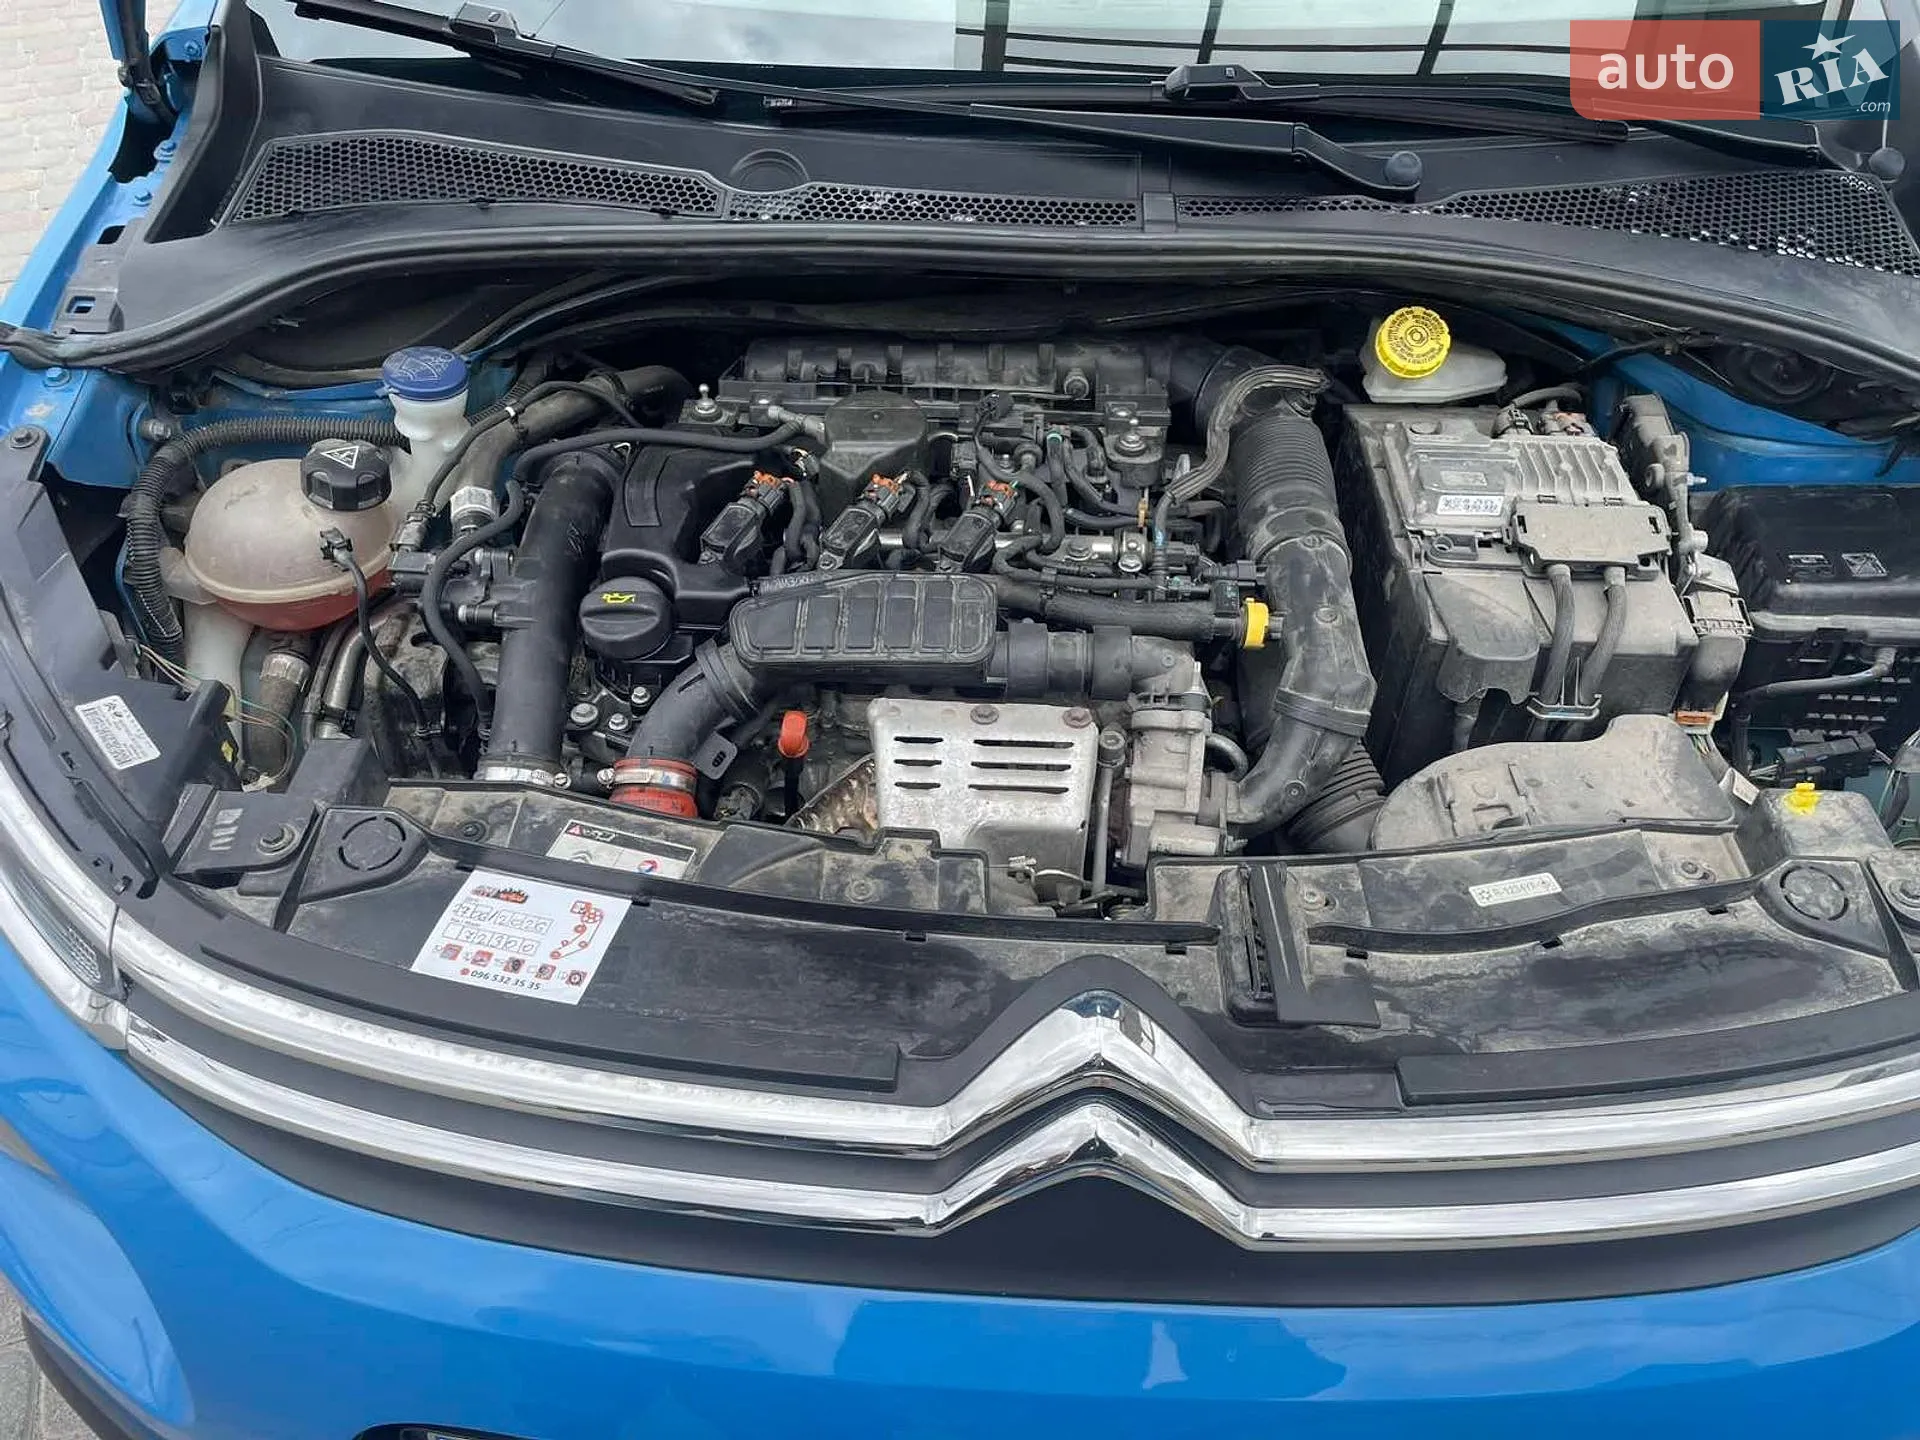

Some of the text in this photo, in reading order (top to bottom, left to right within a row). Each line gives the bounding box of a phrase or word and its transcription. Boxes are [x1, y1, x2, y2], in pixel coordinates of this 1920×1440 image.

[470, 970, 490, 980] 096
[491, 974, 512, 985] 532
[526, 982, 542, 990] 35
